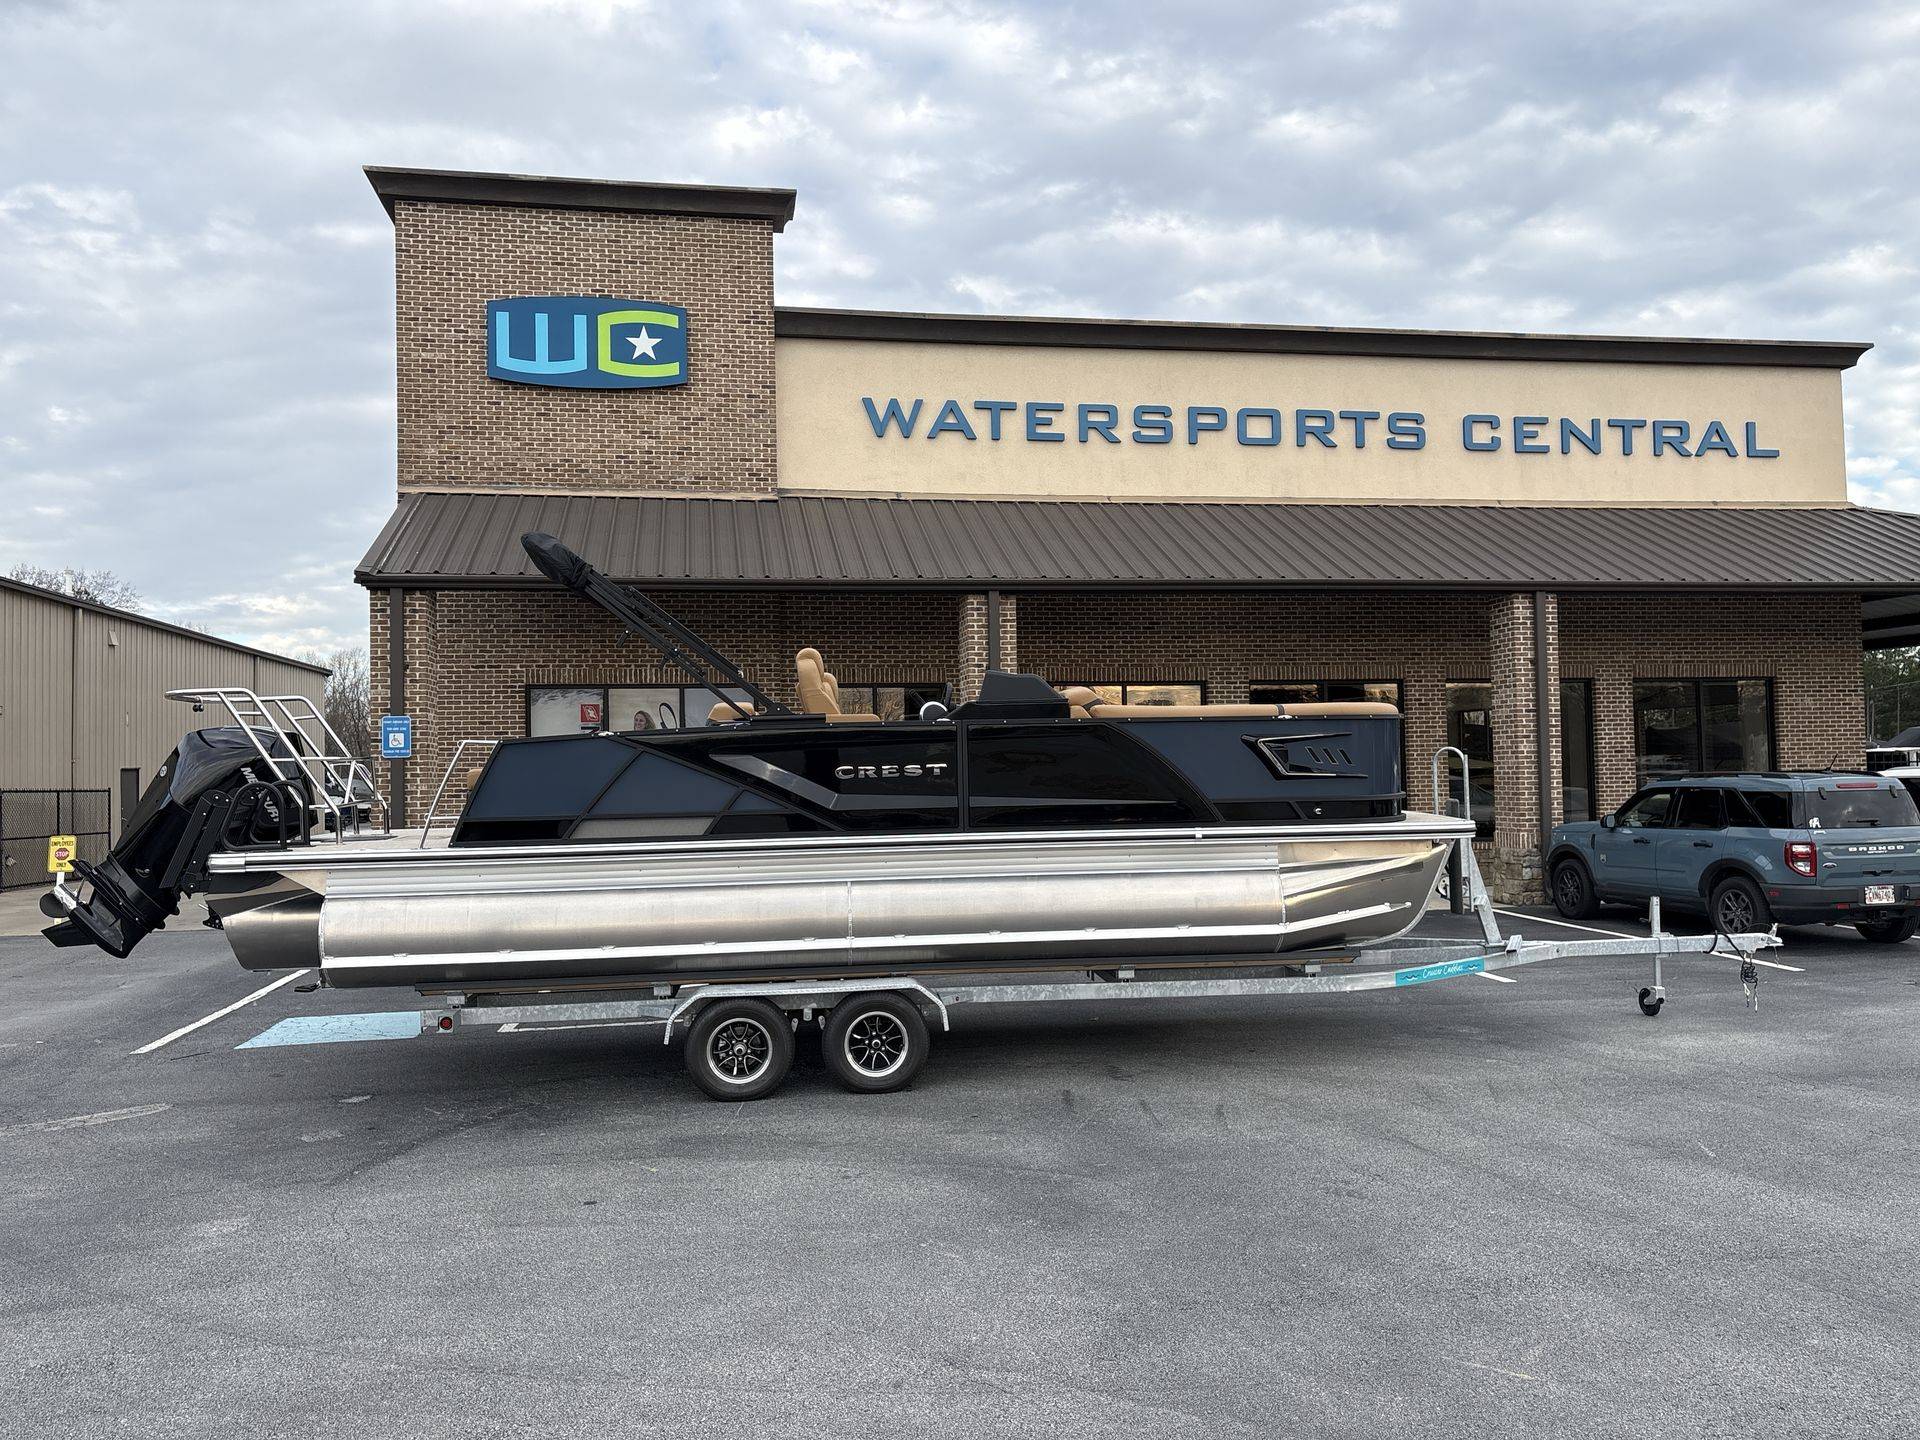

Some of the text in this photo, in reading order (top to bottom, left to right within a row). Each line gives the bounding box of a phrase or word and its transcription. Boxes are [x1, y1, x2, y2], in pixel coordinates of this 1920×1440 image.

[496, 311, 679, 377] WC
[862, 397, 1780, 458] WATERSPORTS CENTRAL
[834, 763, 947, 779] CREST
